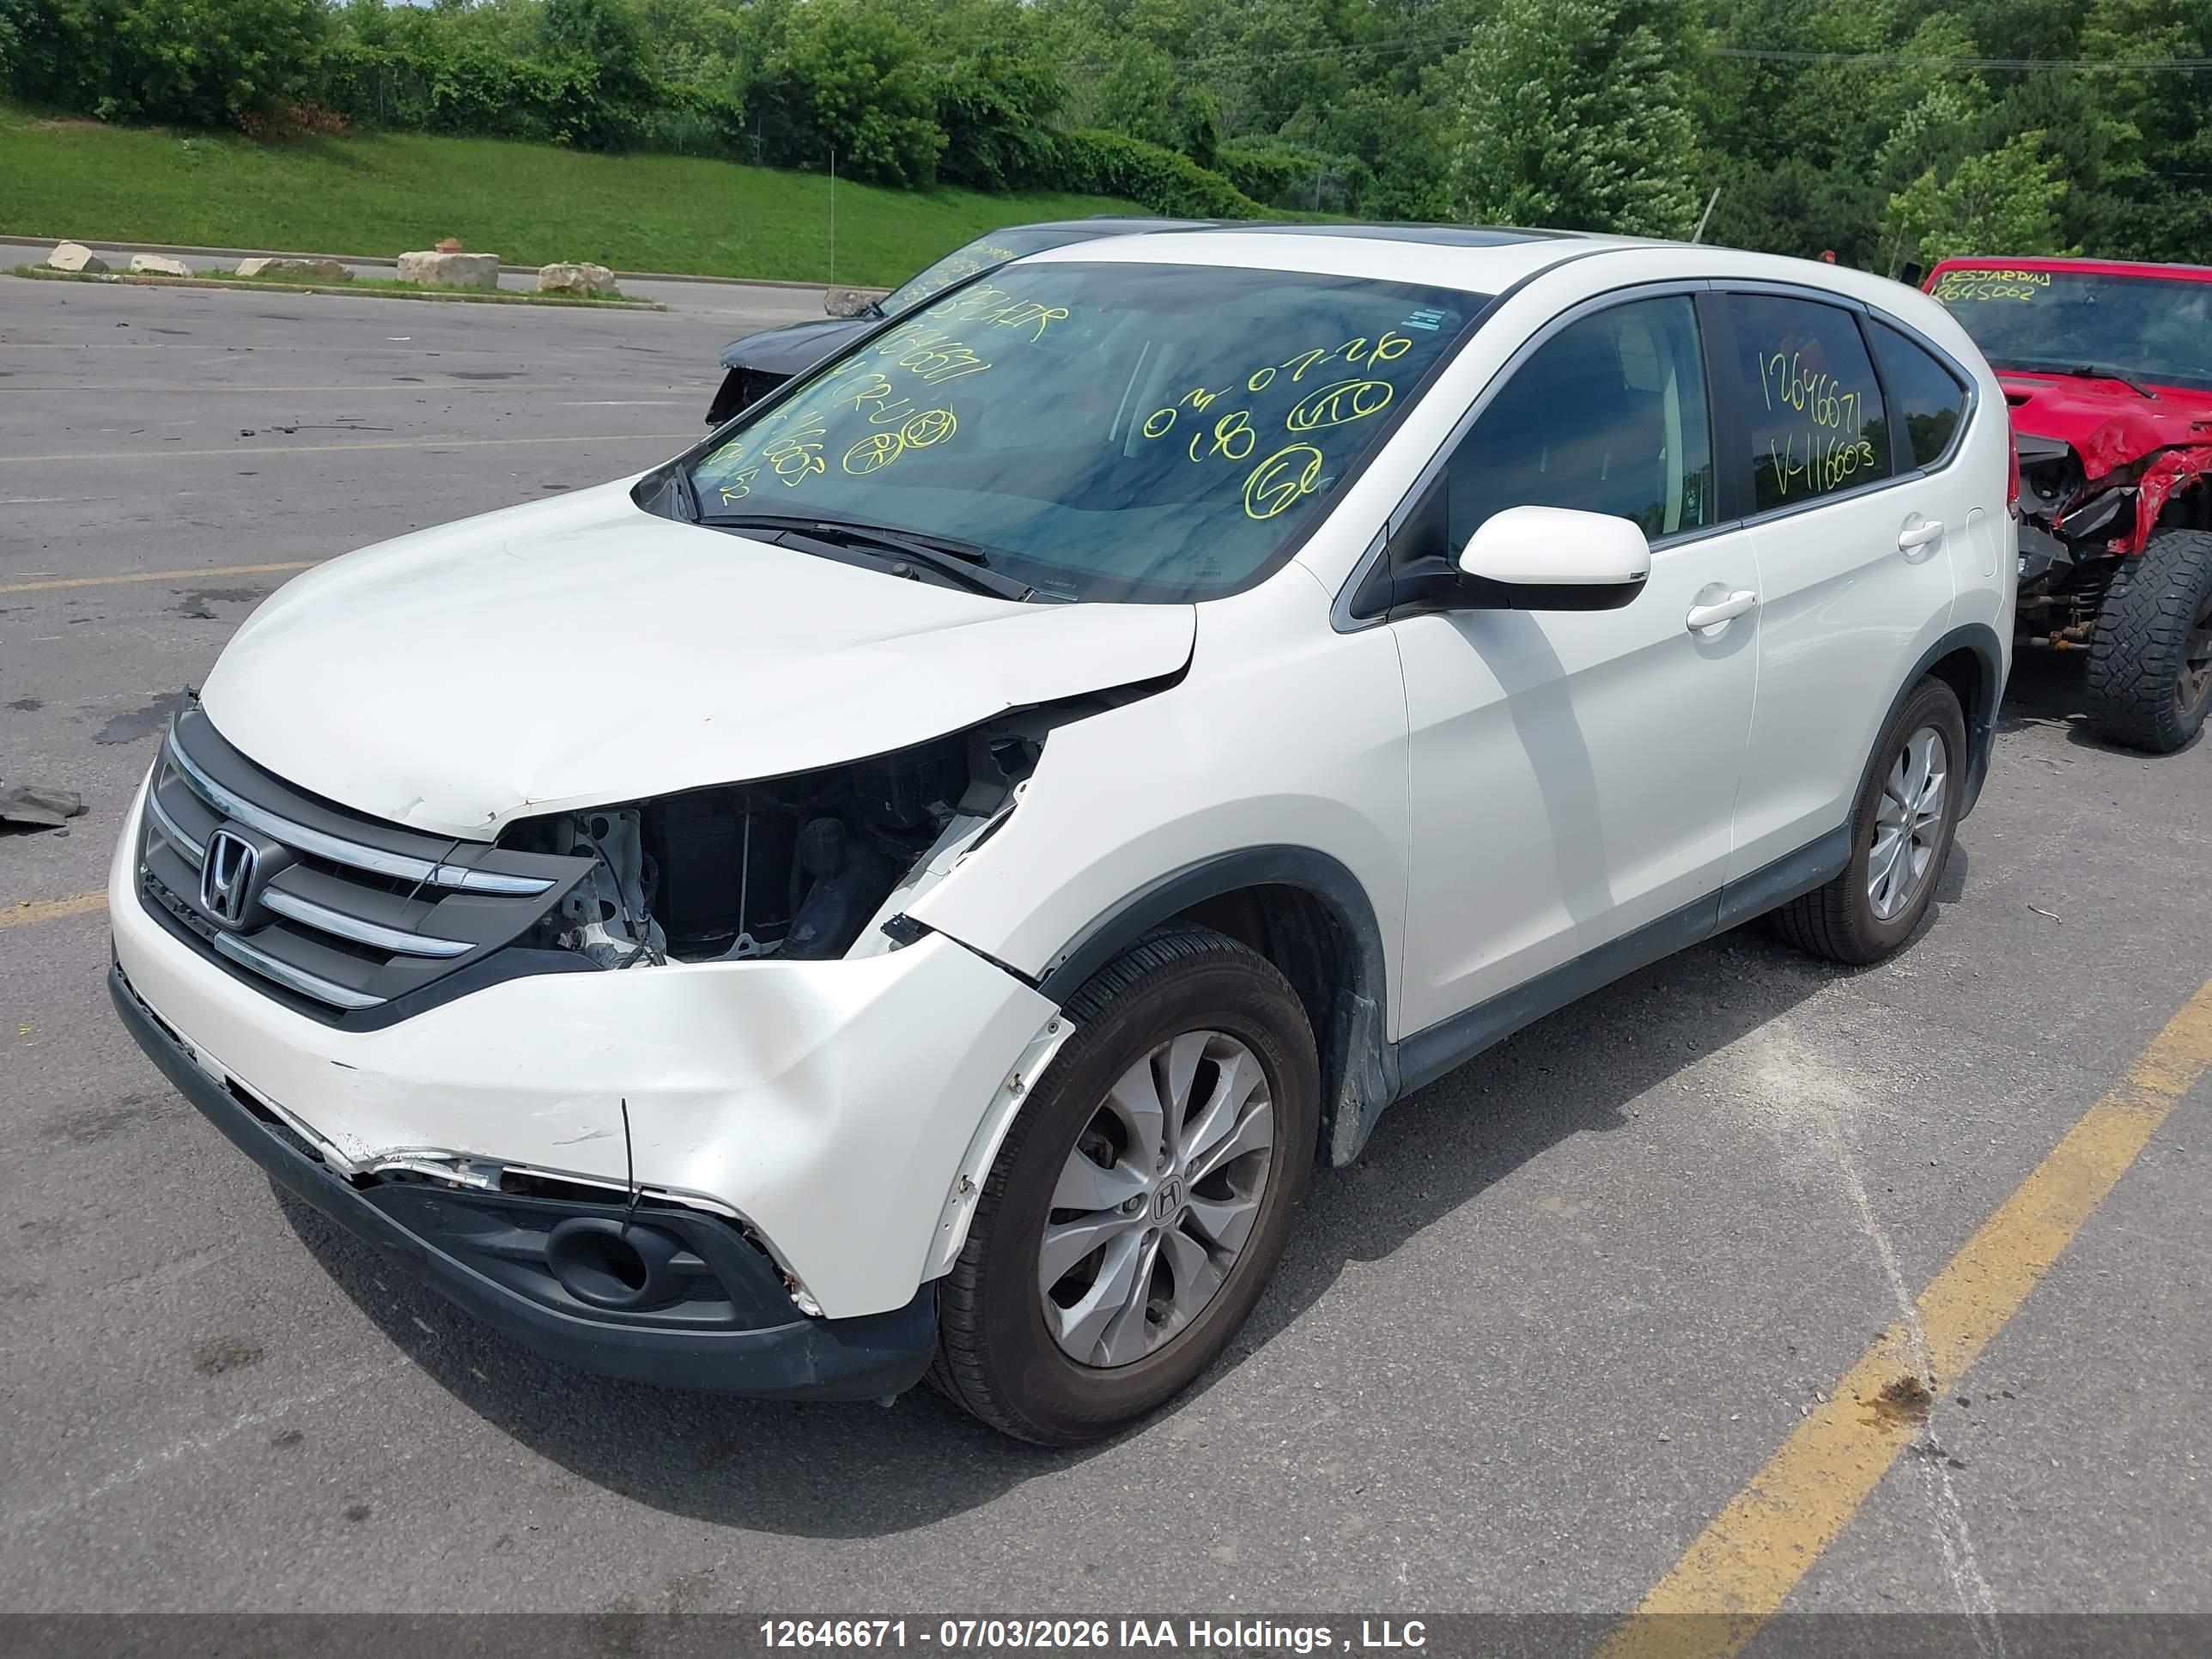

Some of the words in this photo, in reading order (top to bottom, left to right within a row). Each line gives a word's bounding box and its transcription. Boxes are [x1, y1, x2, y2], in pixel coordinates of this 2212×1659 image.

[1942, 270, 2051, 286] DESJARDINS
[1759, 351, 1862, 440] 12646671
[1771, 432, 1875, 495] V-116603
